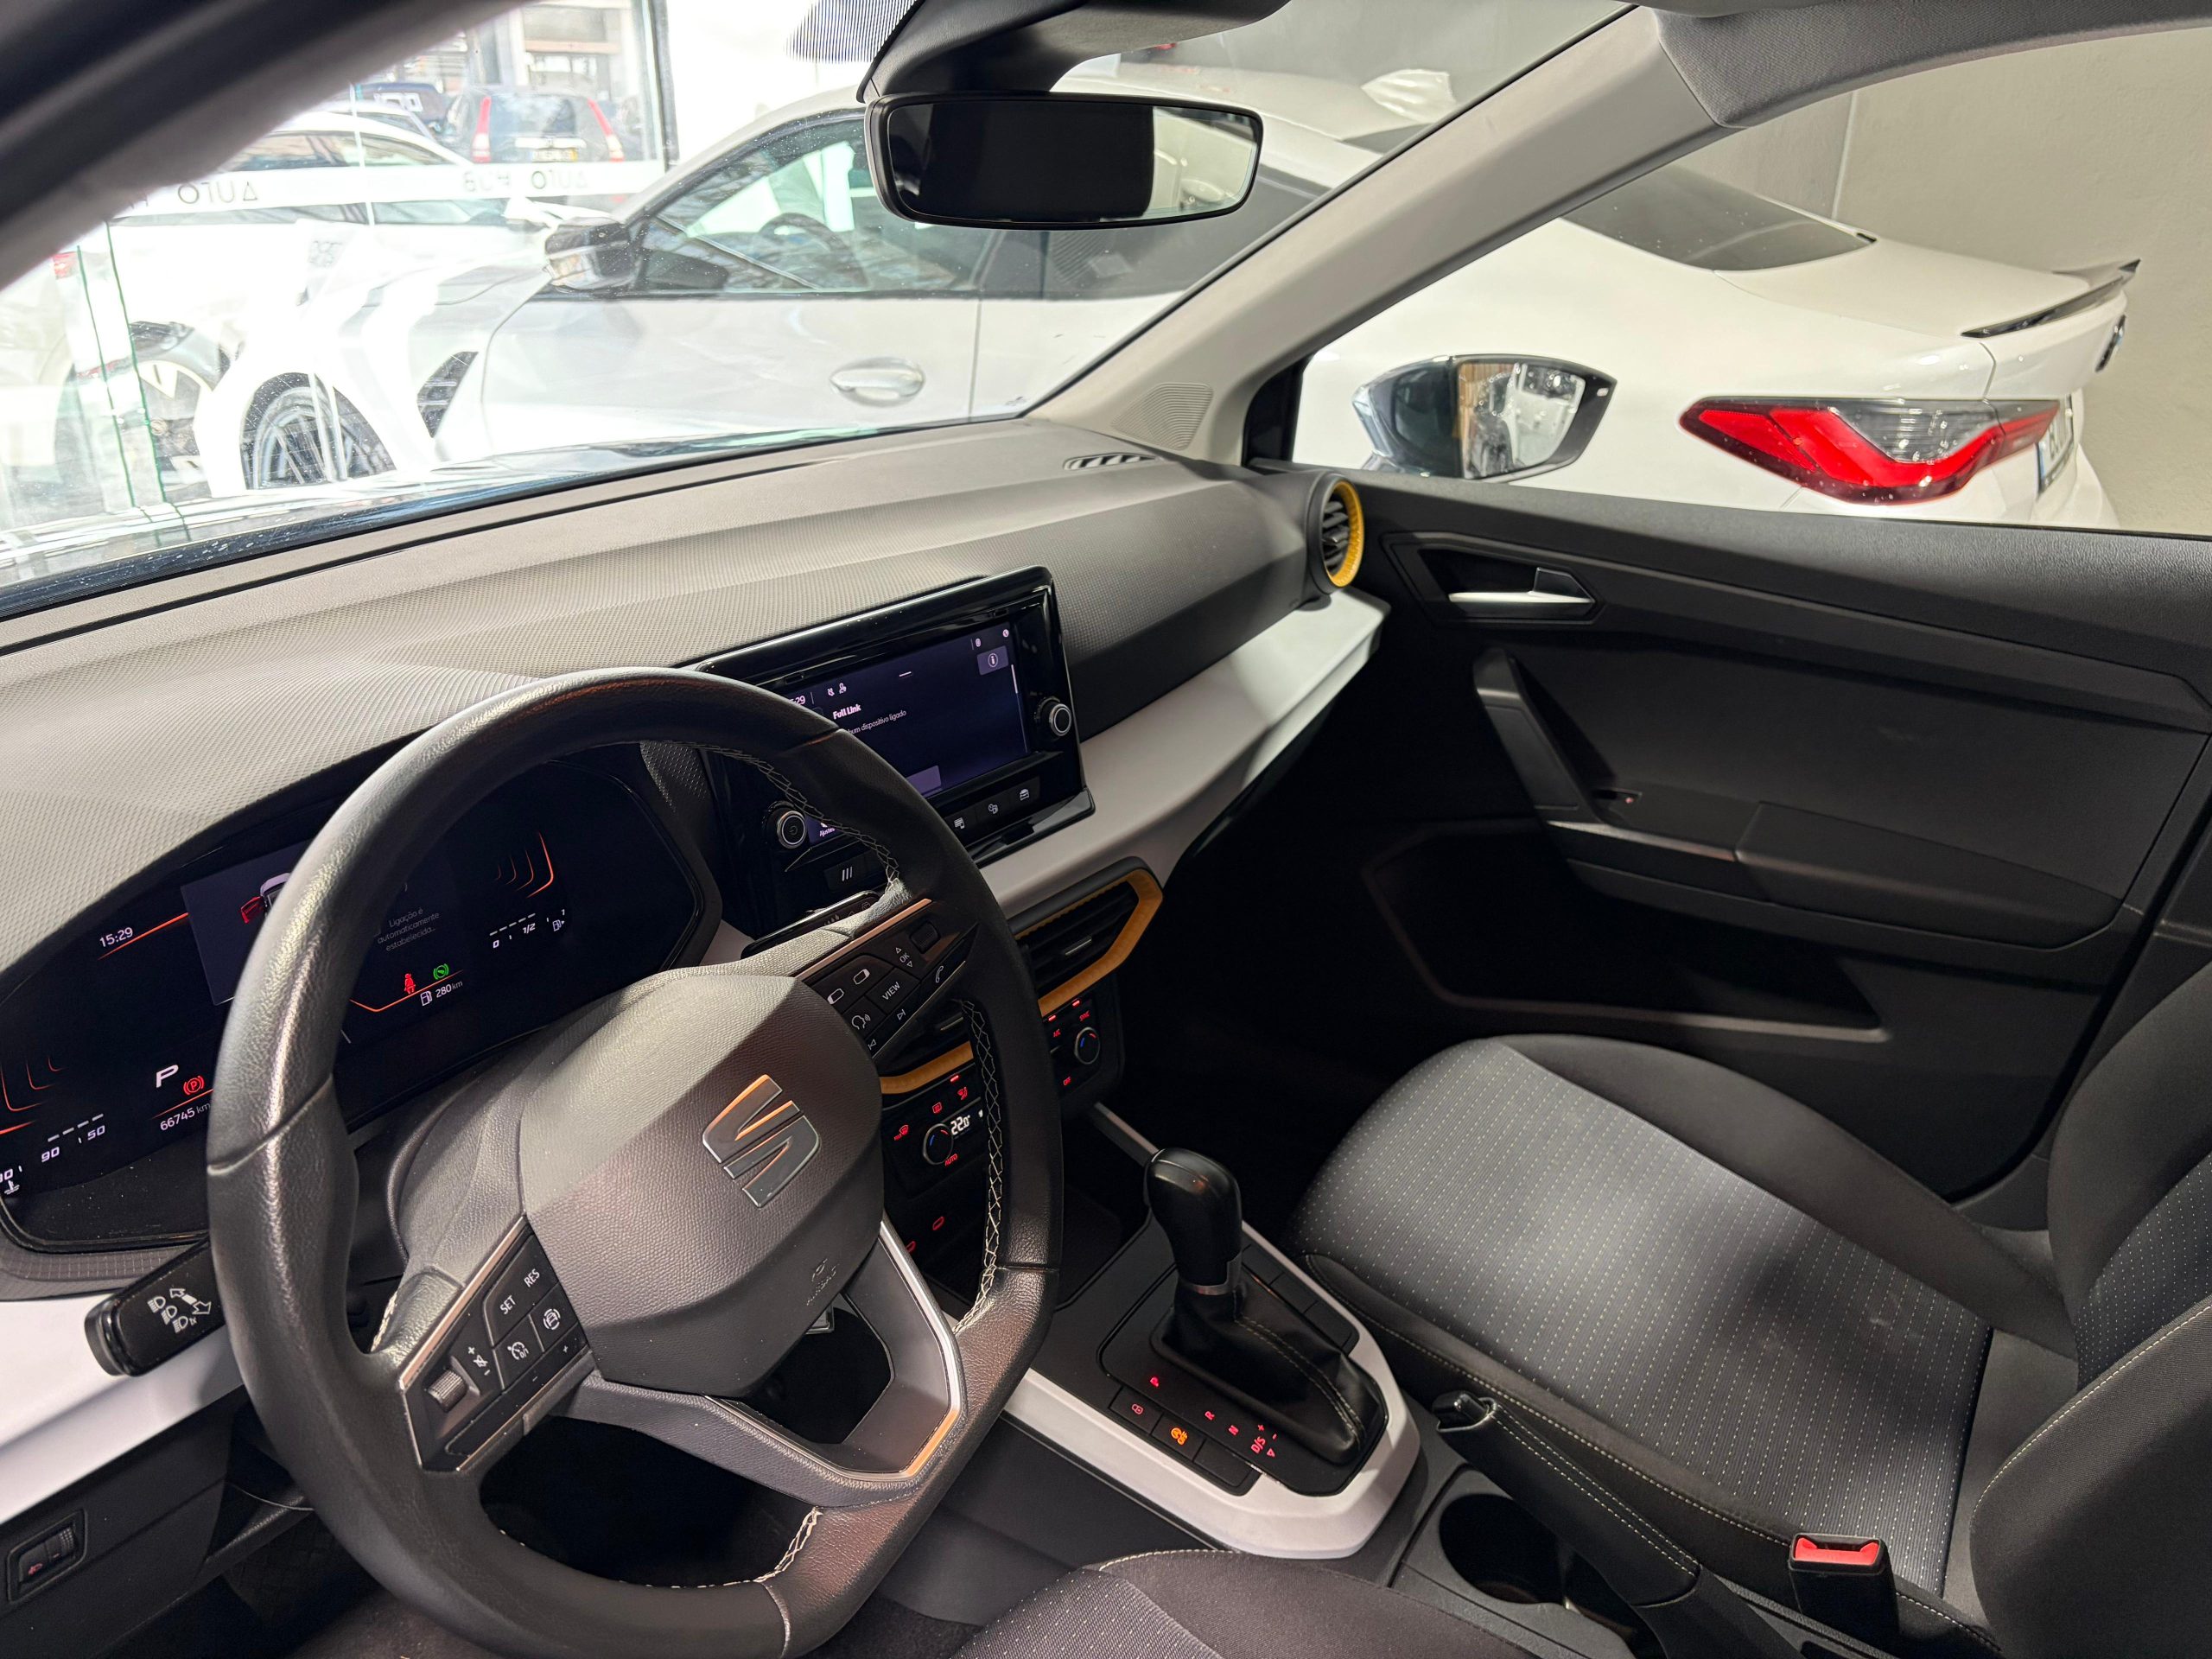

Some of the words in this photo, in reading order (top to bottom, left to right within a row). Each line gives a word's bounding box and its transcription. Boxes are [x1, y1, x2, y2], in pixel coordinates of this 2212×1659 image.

[832, 707, 848, 721] Full
[846, 703, 862, 715] Link
[888, 709, 907, 721] ligado
[377, 912, 440, 944] automaticamente
[389, 910, 418, 928] Ligação
[522, 922, 537, 934] 1/2
[99, 926, 133, 947] 15:29
[493, 939, 499, 949] 0
[899, 952, 910, 963] OK
[881, 981, 900, 1001] VIEW
[156, 1064, 179, 1089] P
[160, 1107, 195, 1131] 66745
[195, 1103, 211, 1114] km
[87, 1125, 105, 1141] 50
[41, 1147, 60, 1163] 90
[944, 1153, 958, 1166] AUTO
[524, 1268, 540, 1287] RES
[499, 1295, 516, 1314] SET
[1205, 1410, 1216, 1421] R
[1228, 1425, 1239, 1436] N
[1250, 1436, 1266, 1454] D/S
